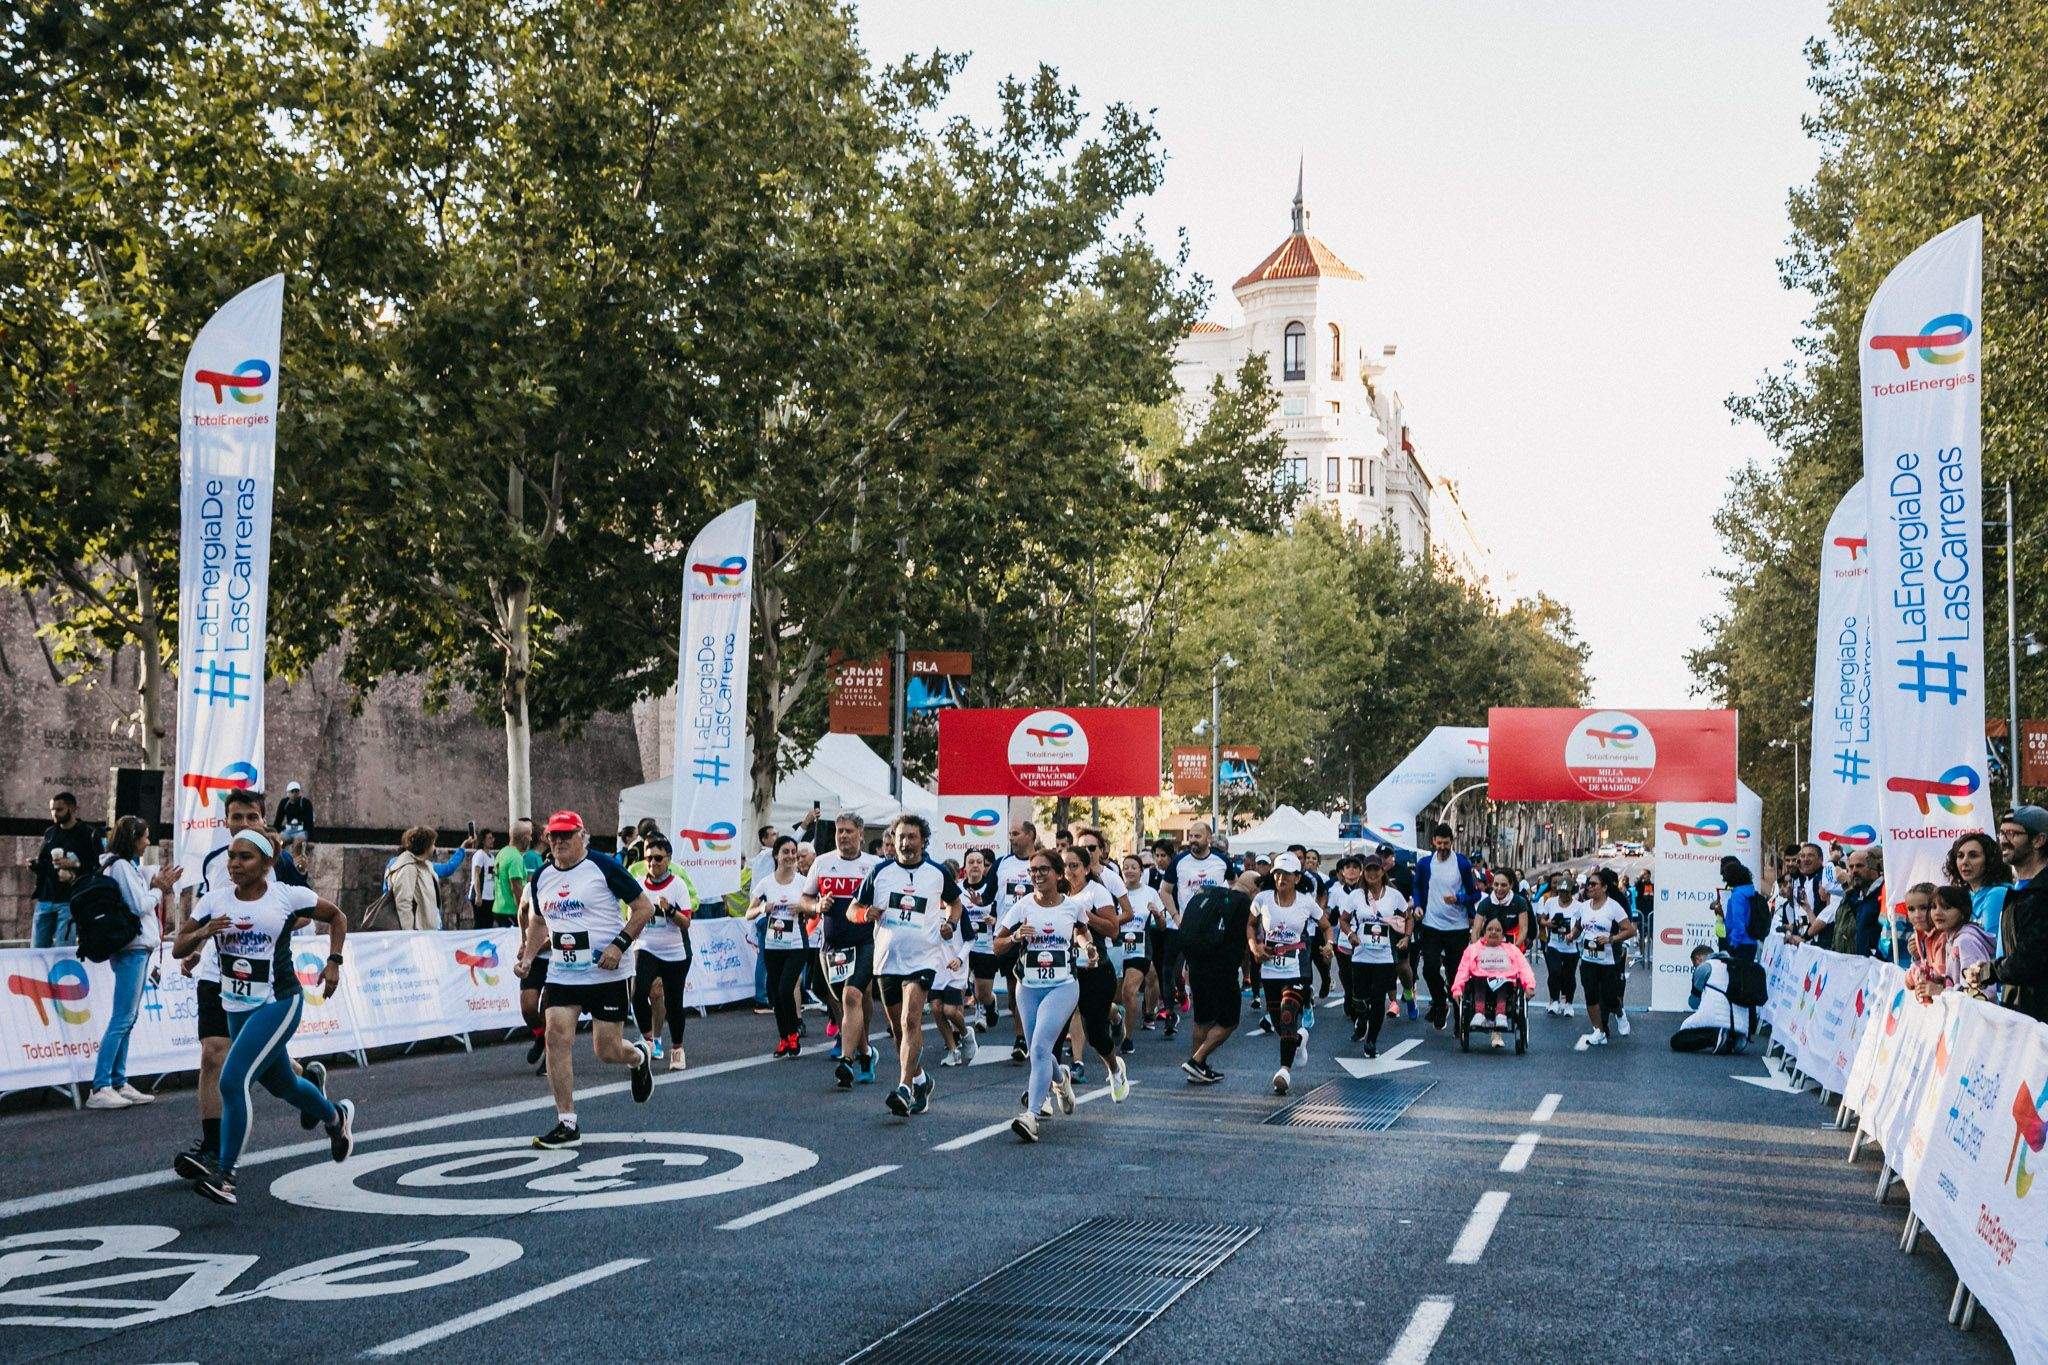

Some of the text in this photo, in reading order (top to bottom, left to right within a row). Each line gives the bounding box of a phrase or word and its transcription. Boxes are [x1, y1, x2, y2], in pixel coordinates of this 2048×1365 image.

[1871, 372, 1976, 398] TotalEnergies
[194, 413, 269, 427] TotalEnergies
[1933, 446, 1972, 641] LasCarreras
[224, 477, 256, 652] LasCarreras
[912, 661, 939, 672] ISLA
[711, 633, 736, 749] LasCarreras
[2029, 732, 2048, 741] FER
[1026, 751, 1074, 759] TotalEnergies
[1586, 754, 1639, 762] TotalEnergies
[1037, 765, 1060, 773] MILLA
[1598, 768, 1624, 776] MILLA
[1020, 772, 1077, 780] INTERNACIONAL
[1579, 776, 1643, 784] INTERNACIONAL
[680, 858, 737, 867] otalEnergies
[1664, 851, 1723, 863] TotalEnergie
[1677, 890, 1714, 901] MADR
[562, 949, 577, 963] 55
[1037, 968, 1055, 980] 128
[230, 980, 251, 997] 121
[22, 1037, 99, 1061] TotalEnergie
